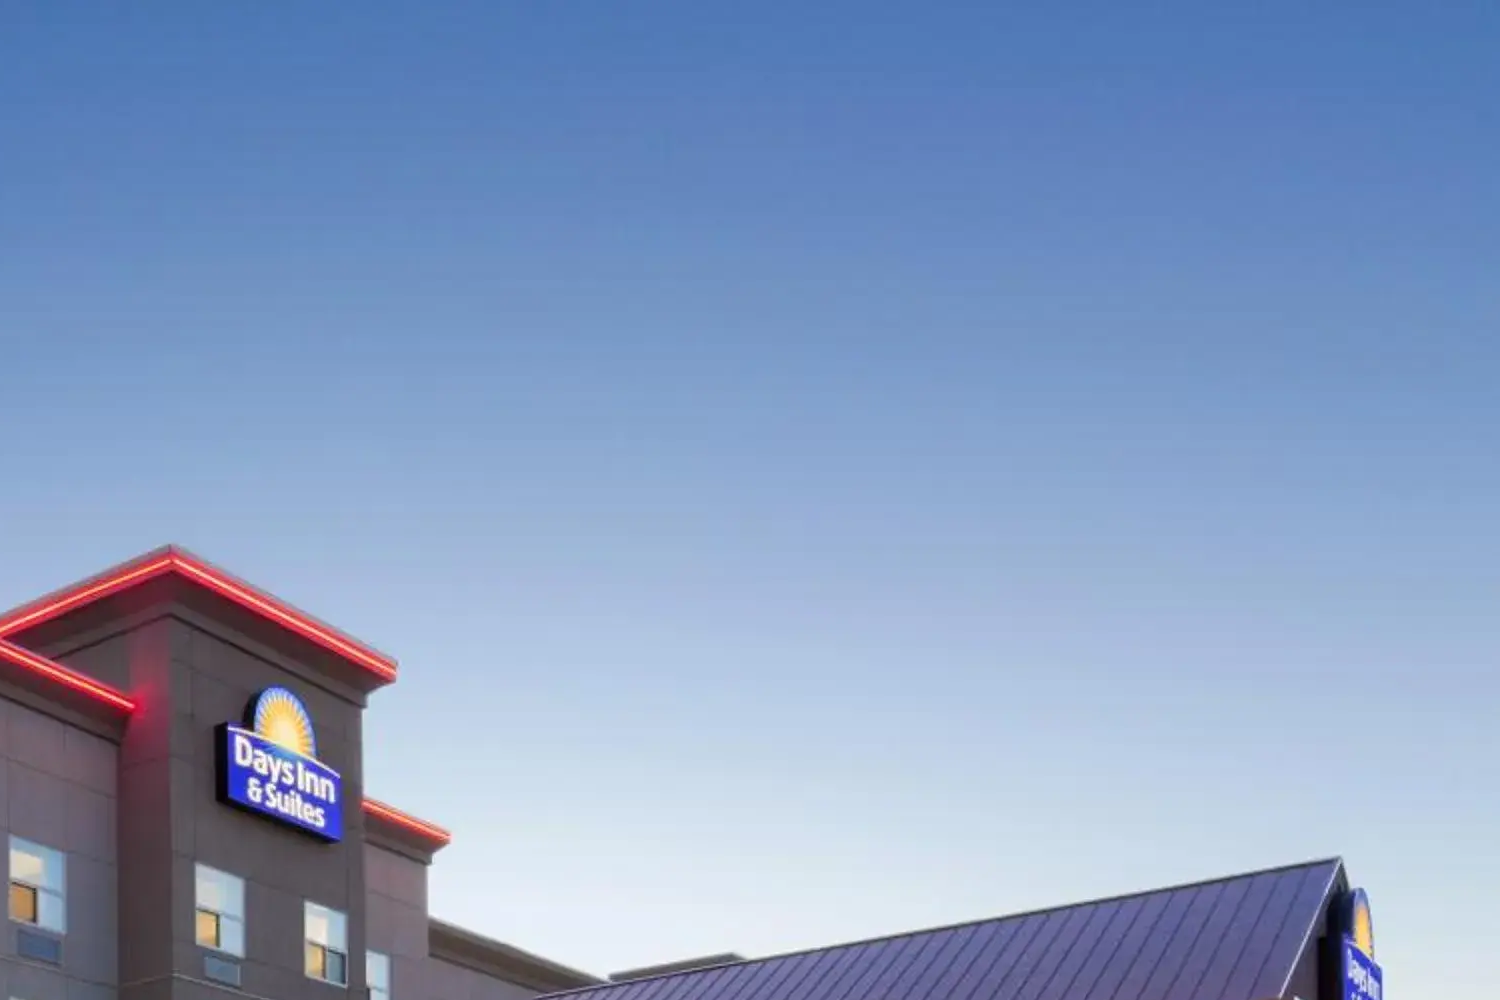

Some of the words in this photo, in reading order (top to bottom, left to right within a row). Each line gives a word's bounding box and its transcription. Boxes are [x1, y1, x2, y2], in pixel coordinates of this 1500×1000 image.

[234, 734, 295, 785] Days
[297, 760, 336, 804] Inn
[247, 777, 263, 803] &
[265, 782, 326, 828] Suites
